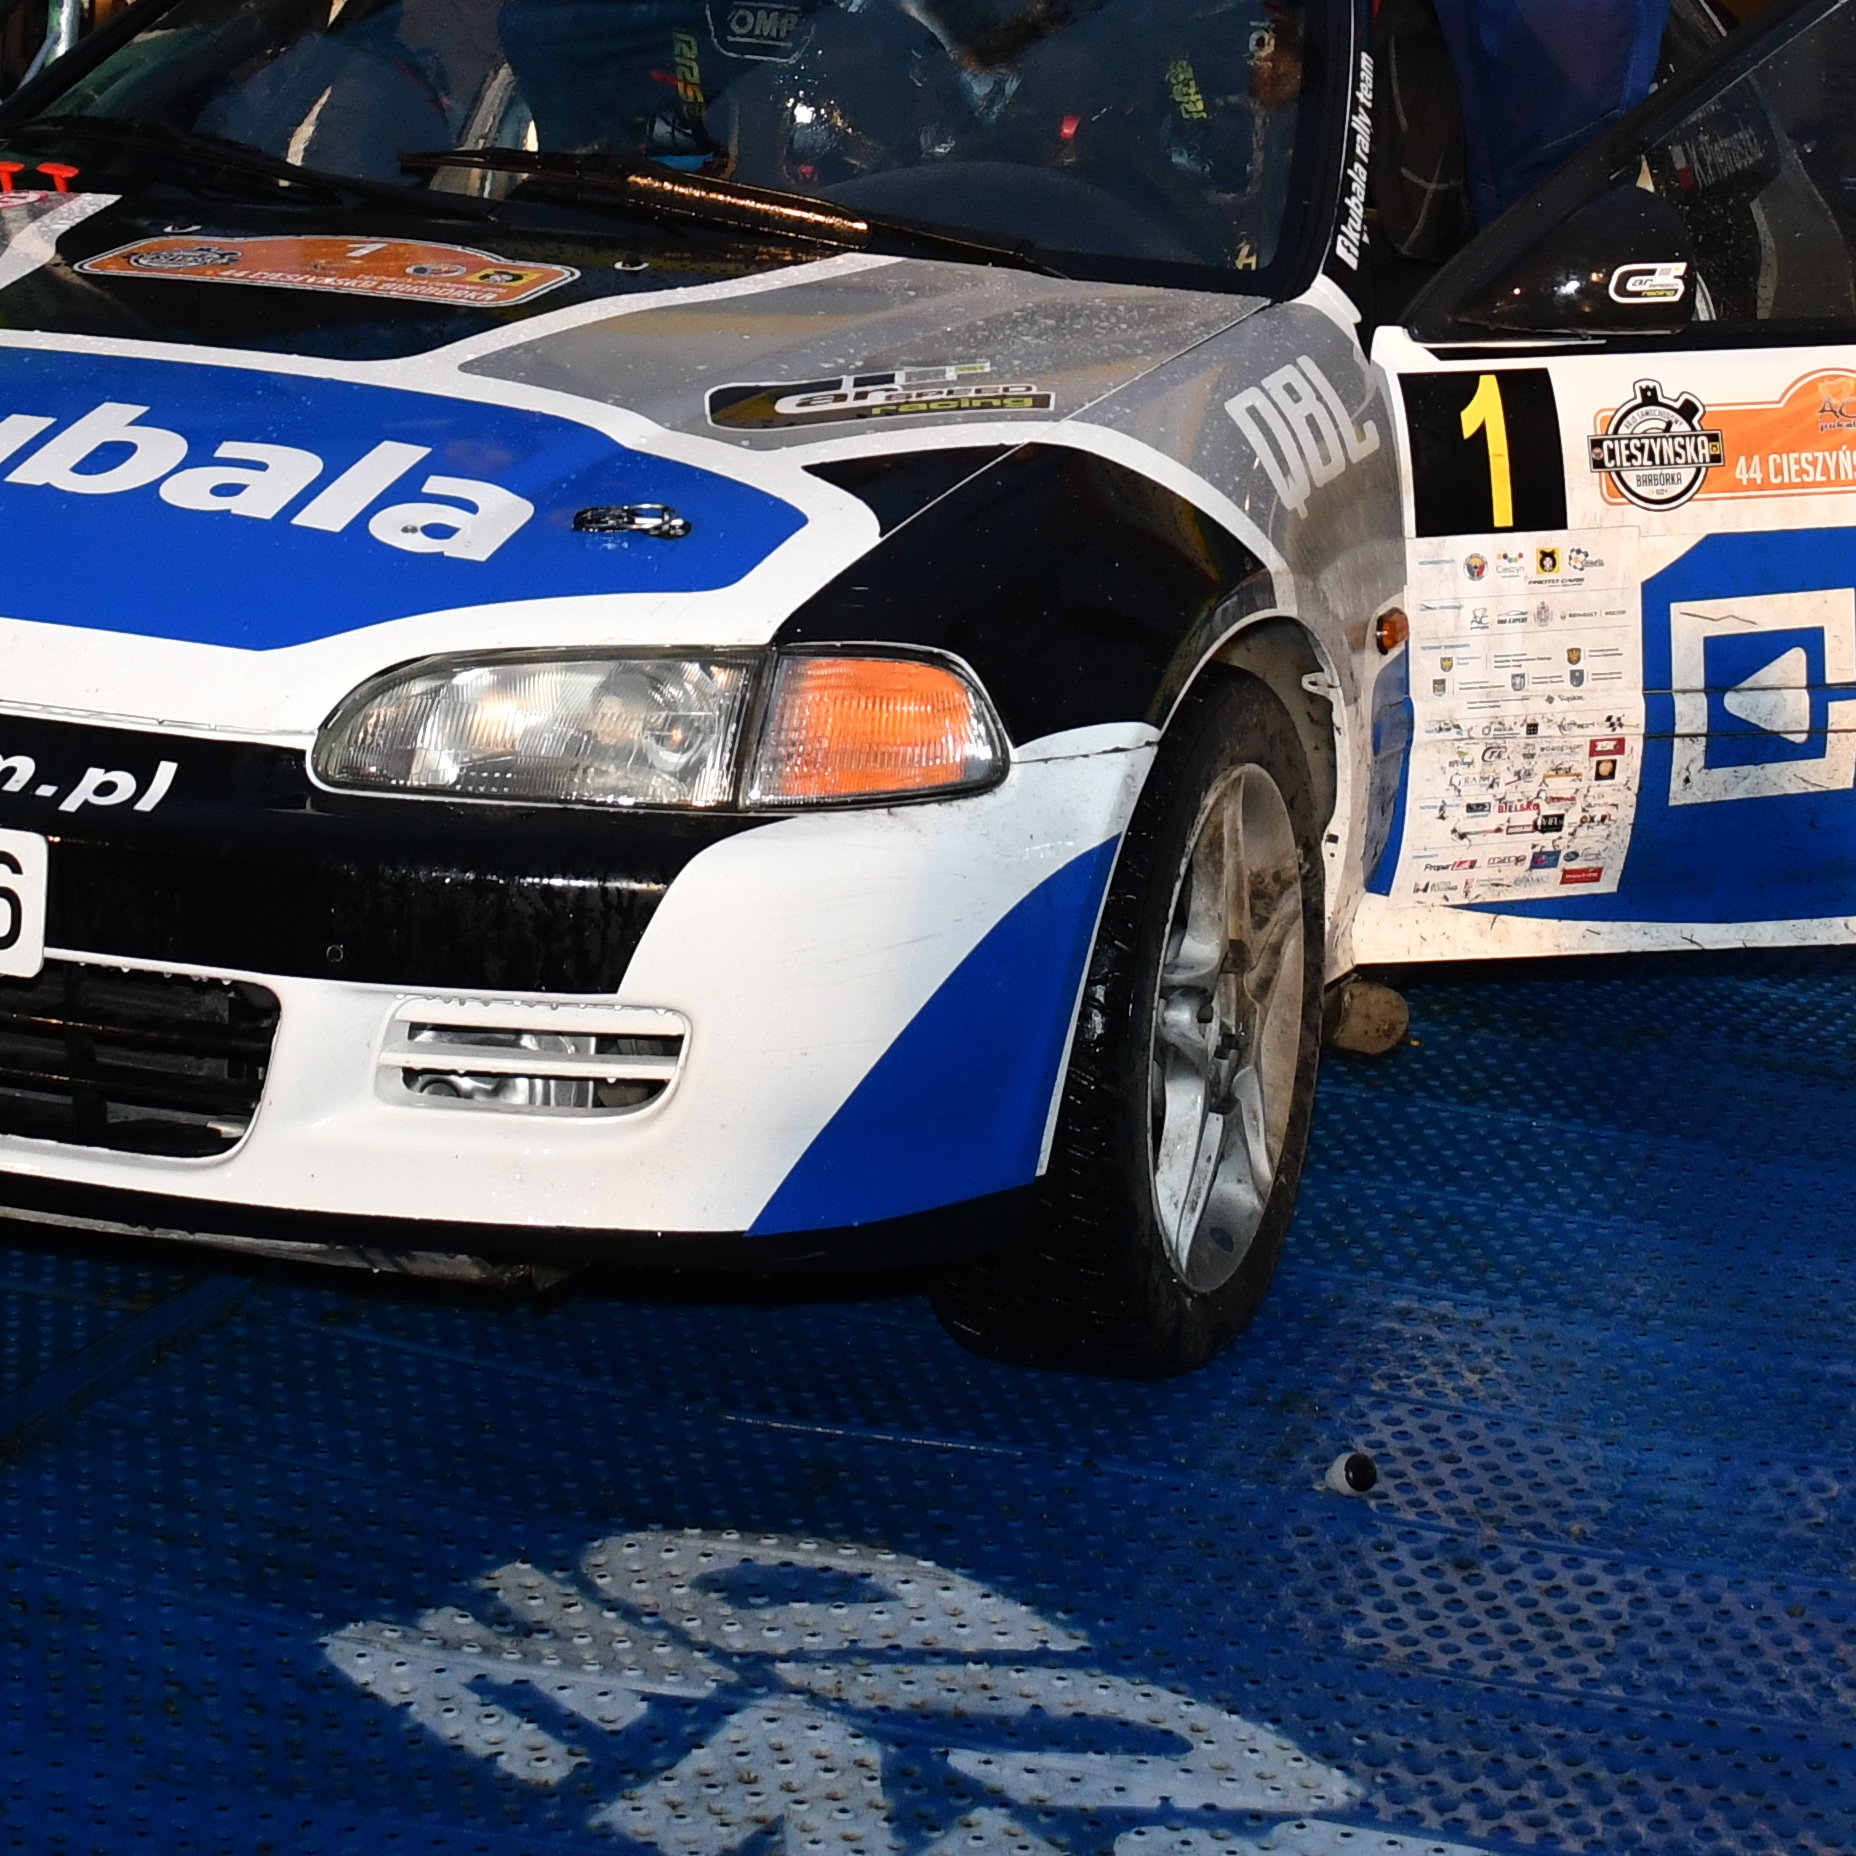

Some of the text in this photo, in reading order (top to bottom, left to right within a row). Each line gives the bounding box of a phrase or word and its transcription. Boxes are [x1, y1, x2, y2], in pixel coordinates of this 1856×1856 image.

[729, 6, 800, 40] OMP
[1460, 373, 1515, 528] 1
[1602, 433, 1711, 468] CIESZYŃSKA
[1734, 454, 1763, 486] 44
